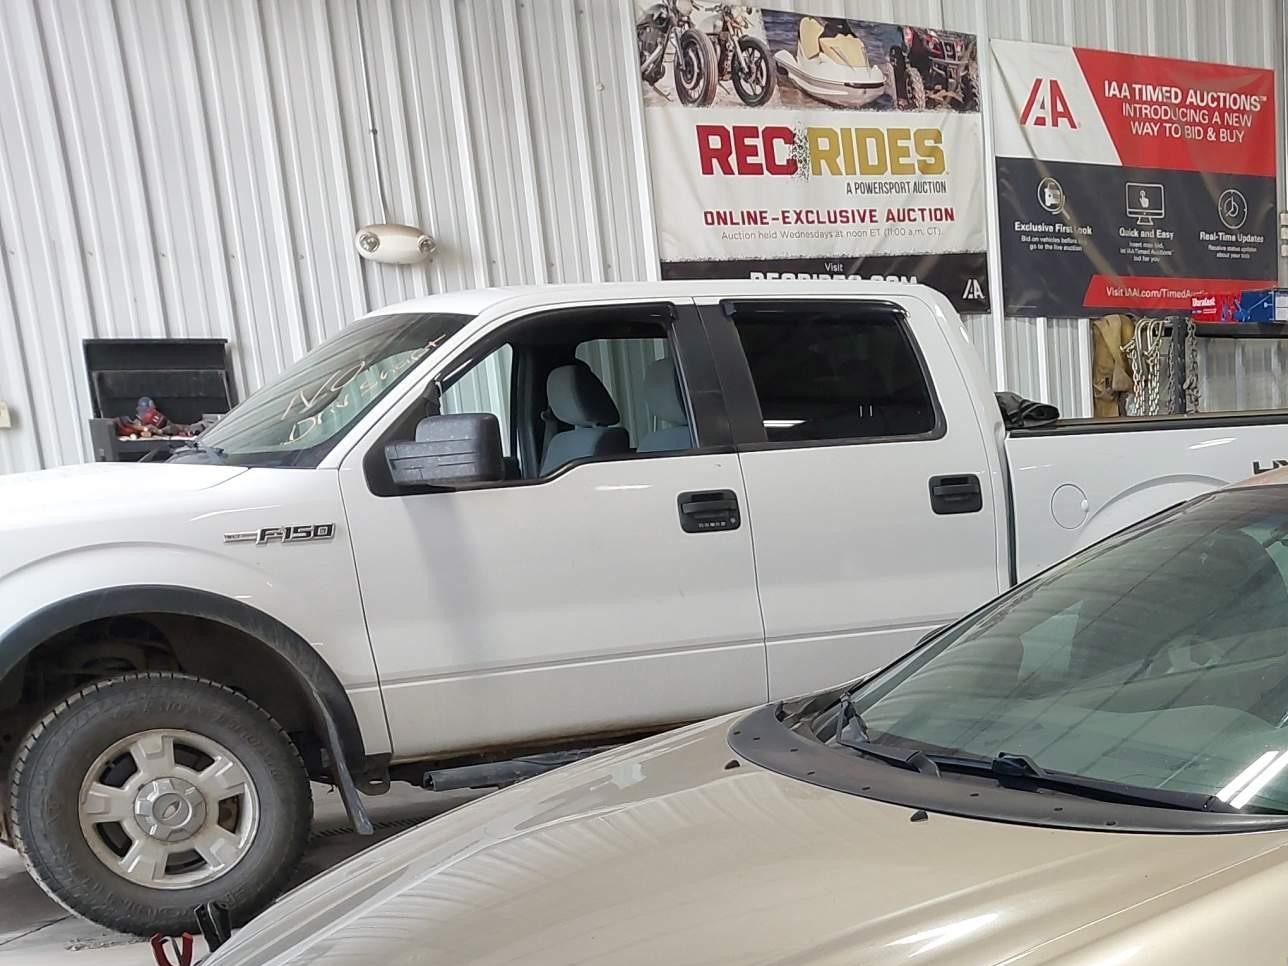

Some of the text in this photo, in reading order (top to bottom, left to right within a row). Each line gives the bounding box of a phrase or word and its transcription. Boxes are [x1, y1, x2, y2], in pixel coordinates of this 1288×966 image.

[1104, 80, 1131, 99] IAA
[1133, 83, 1182, 104] TIMED
[1122, 102, 1253, 127] INTRODUCING A NEW
[1131, 121, 1245, 143] WAY TO BID & BUY
[695, 124, 947, 176] REC RIDES
[846, 180, 947, 195] A POWERSPORT AUCTION
[703, 207, 956, 226] ONLINE-EXCLUSIVE AUCTION
[721, 231, 756, 240] Auction
[758, 230, 778, 240] held
[780, 230, 833, 240] Wednesdays
[846, 229, 867, 238] noon
[870, 228, 880, 237] ET
[1014, 221, 1054, 233] Exclusive
[1119, 227, 1174, 241] Quick and Easy
[1199, 231, 1264, 244] Real-Time Updates
[824, 262, 843, 272] Visit
[1106, 286, 1124, 297] Visit
